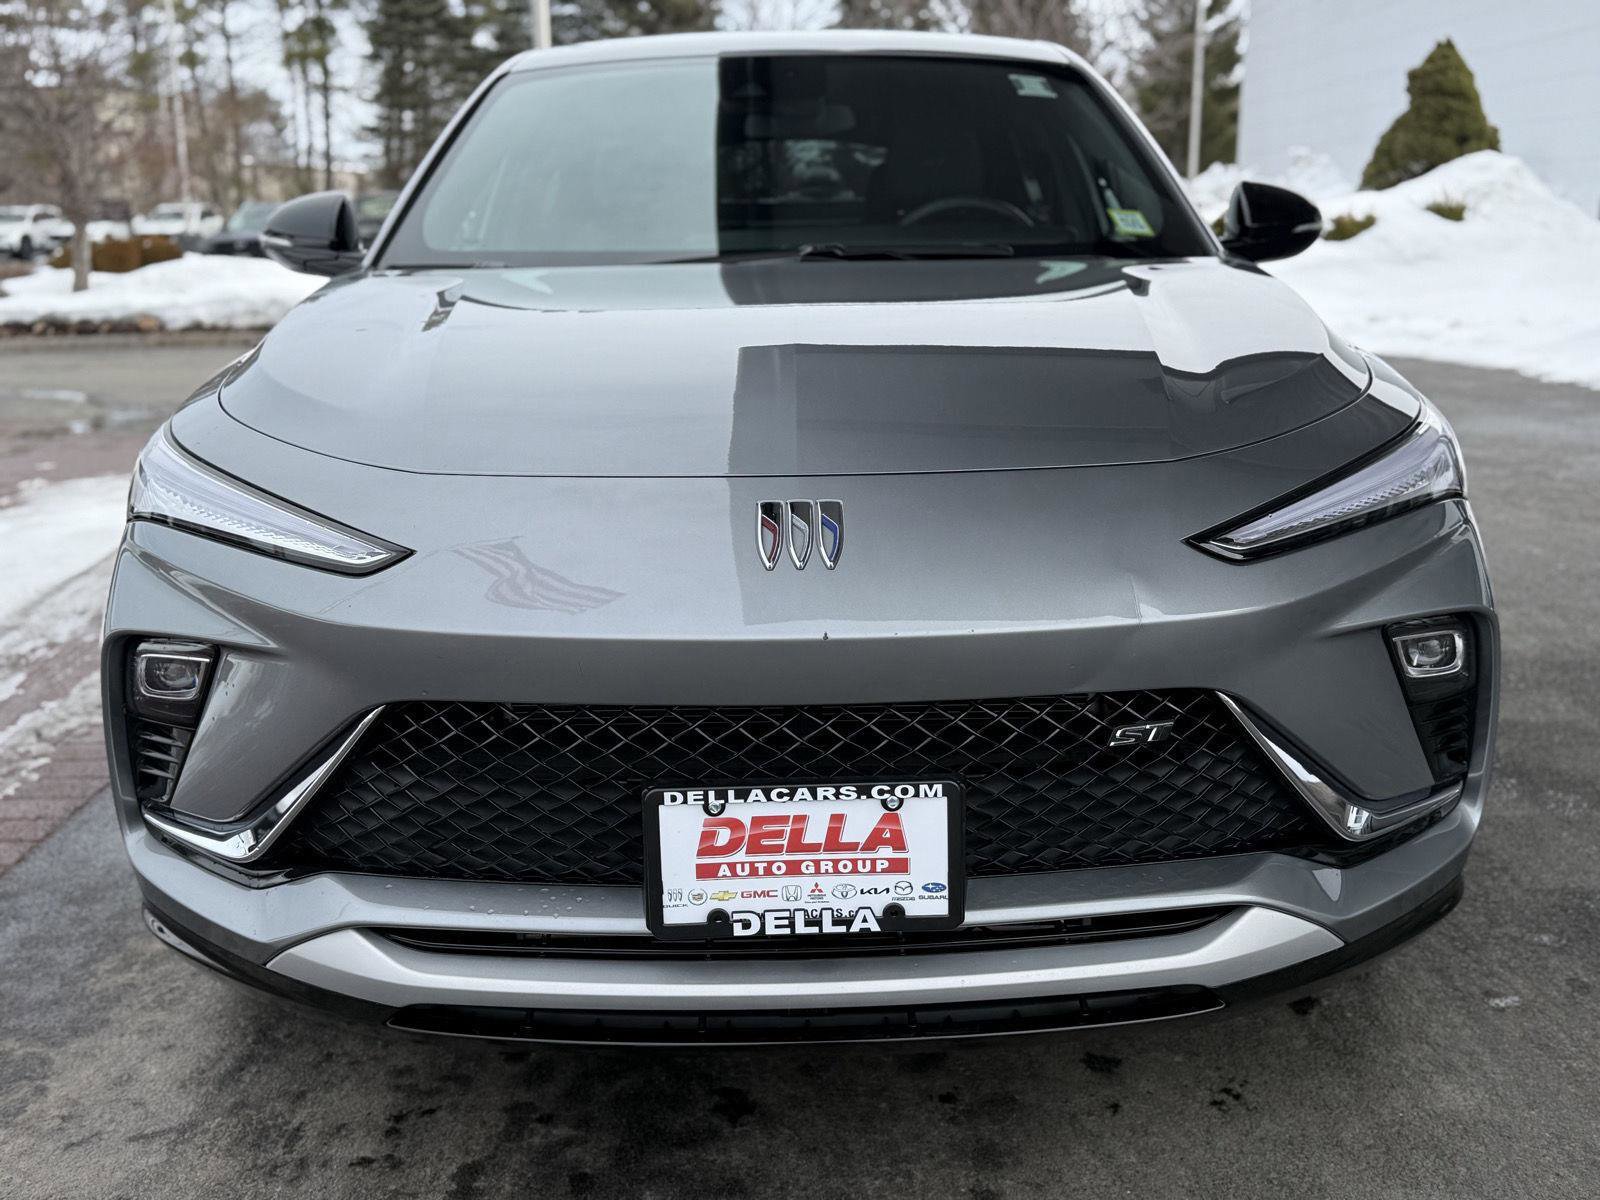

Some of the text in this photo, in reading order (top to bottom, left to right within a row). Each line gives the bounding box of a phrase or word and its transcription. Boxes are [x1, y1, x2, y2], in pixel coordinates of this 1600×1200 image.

[1109, 721, 1174, 747] ST
[663, 783, 943, 806] DELLACARS.COM
[696, 811, 910, 859] DELLA
[717, 859, 890, 877] AUTO GROUP
[740, 889, 778, 899] GMC
[732, 907, 882, 937] DELLA
